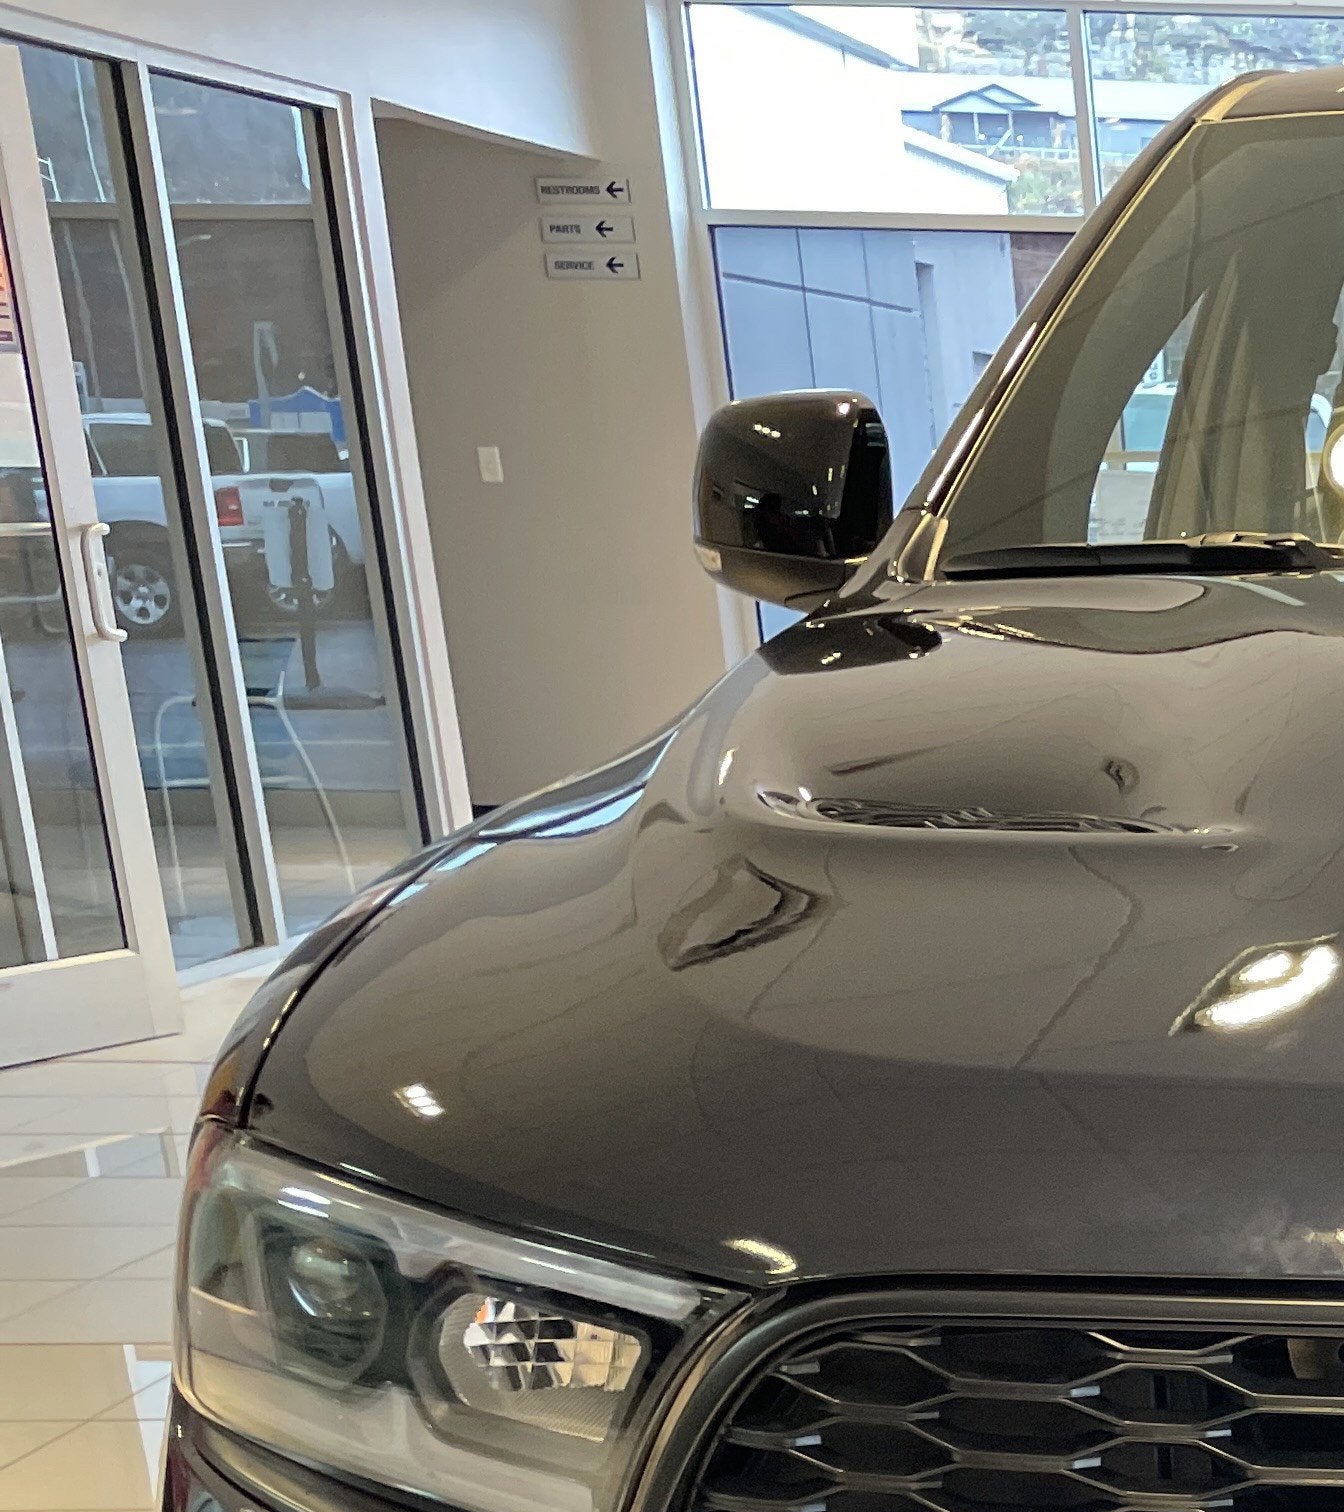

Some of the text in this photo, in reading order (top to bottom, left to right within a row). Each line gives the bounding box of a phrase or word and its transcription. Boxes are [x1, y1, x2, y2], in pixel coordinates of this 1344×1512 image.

[540, 185, 601, 195] RESTROOMS
[549, 224, 582, 234] PARTS
[554, 260, 595, 270] SERVICE
